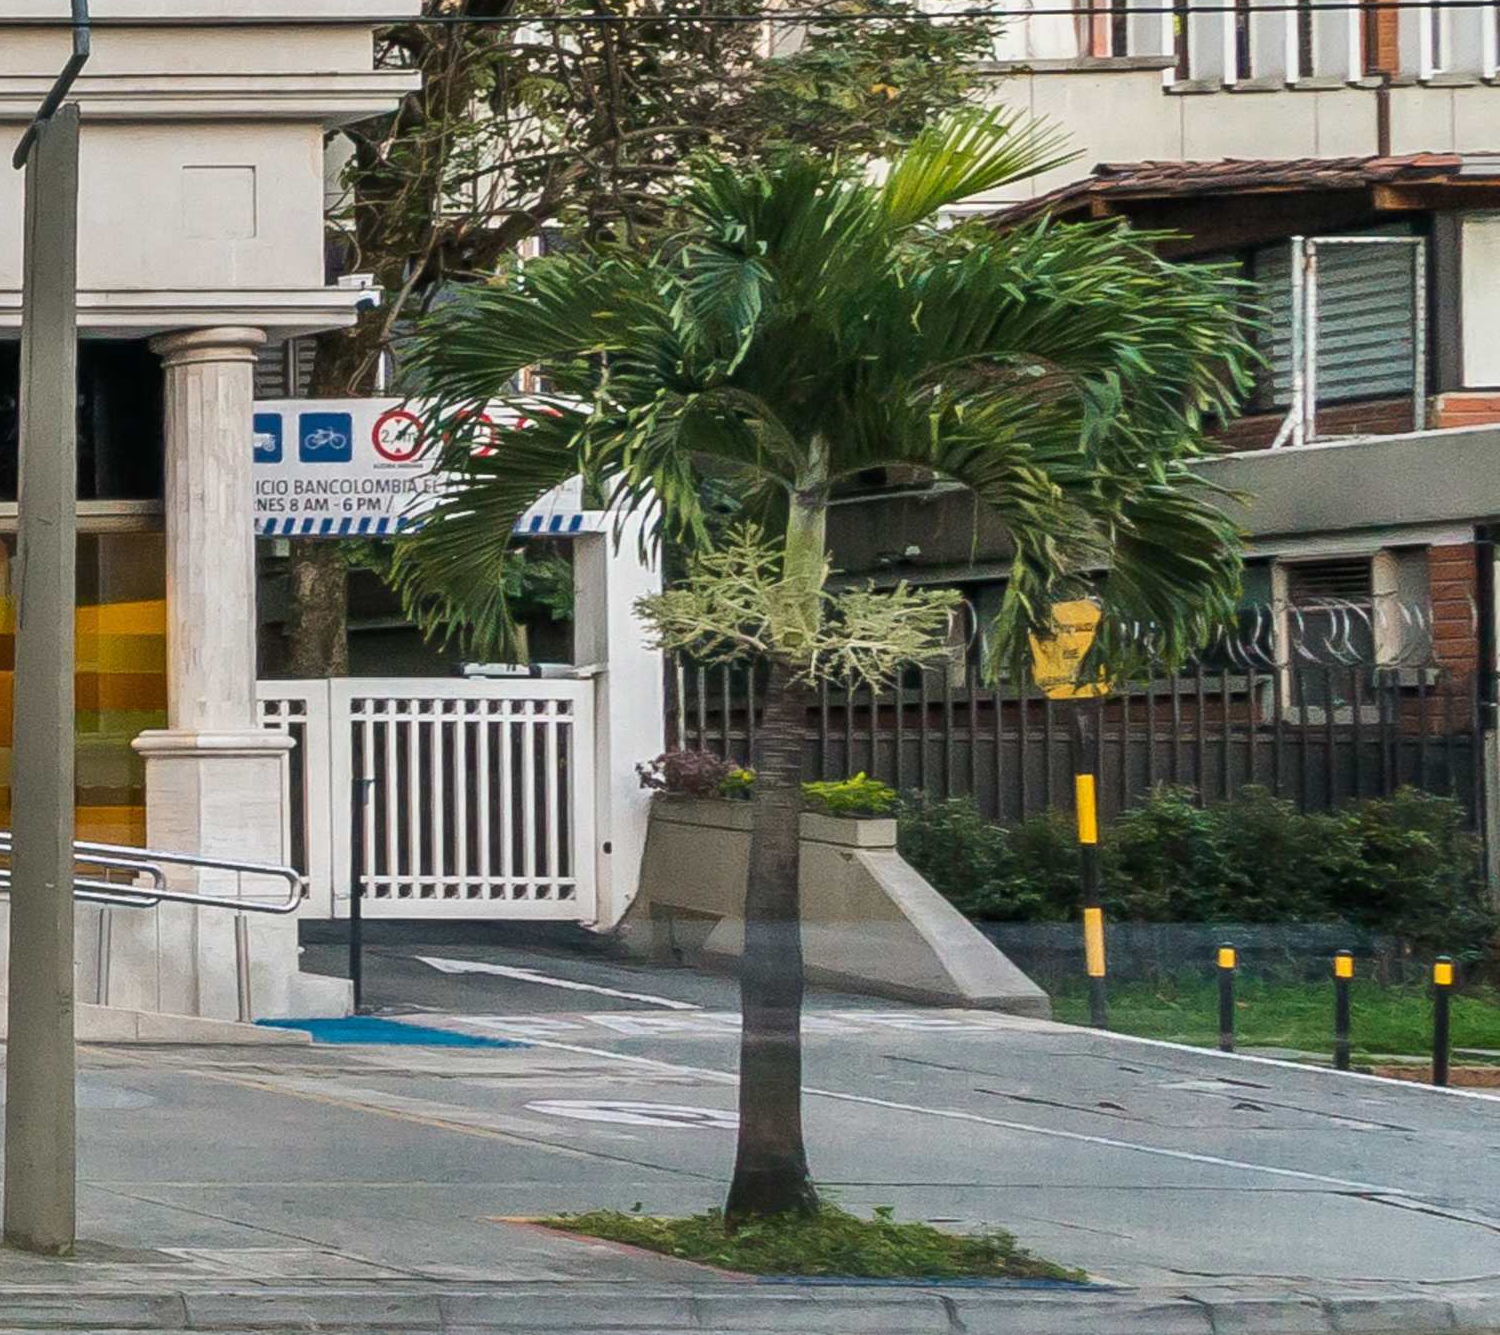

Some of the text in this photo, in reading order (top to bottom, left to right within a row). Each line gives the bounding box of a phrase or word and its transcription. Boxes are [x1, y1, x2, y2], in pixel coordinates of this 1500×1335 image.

[255, 479, 288, 495] ICIO
[294, 479, 418, 495] BANCOLOMBIA
[255, 497, 285, 512] NES
[290, 497, 299, 512] 8
[303, 497, 330, 512] AM
[342, 497, 353, 512] 6
[357, 496, 382, 511] PM
